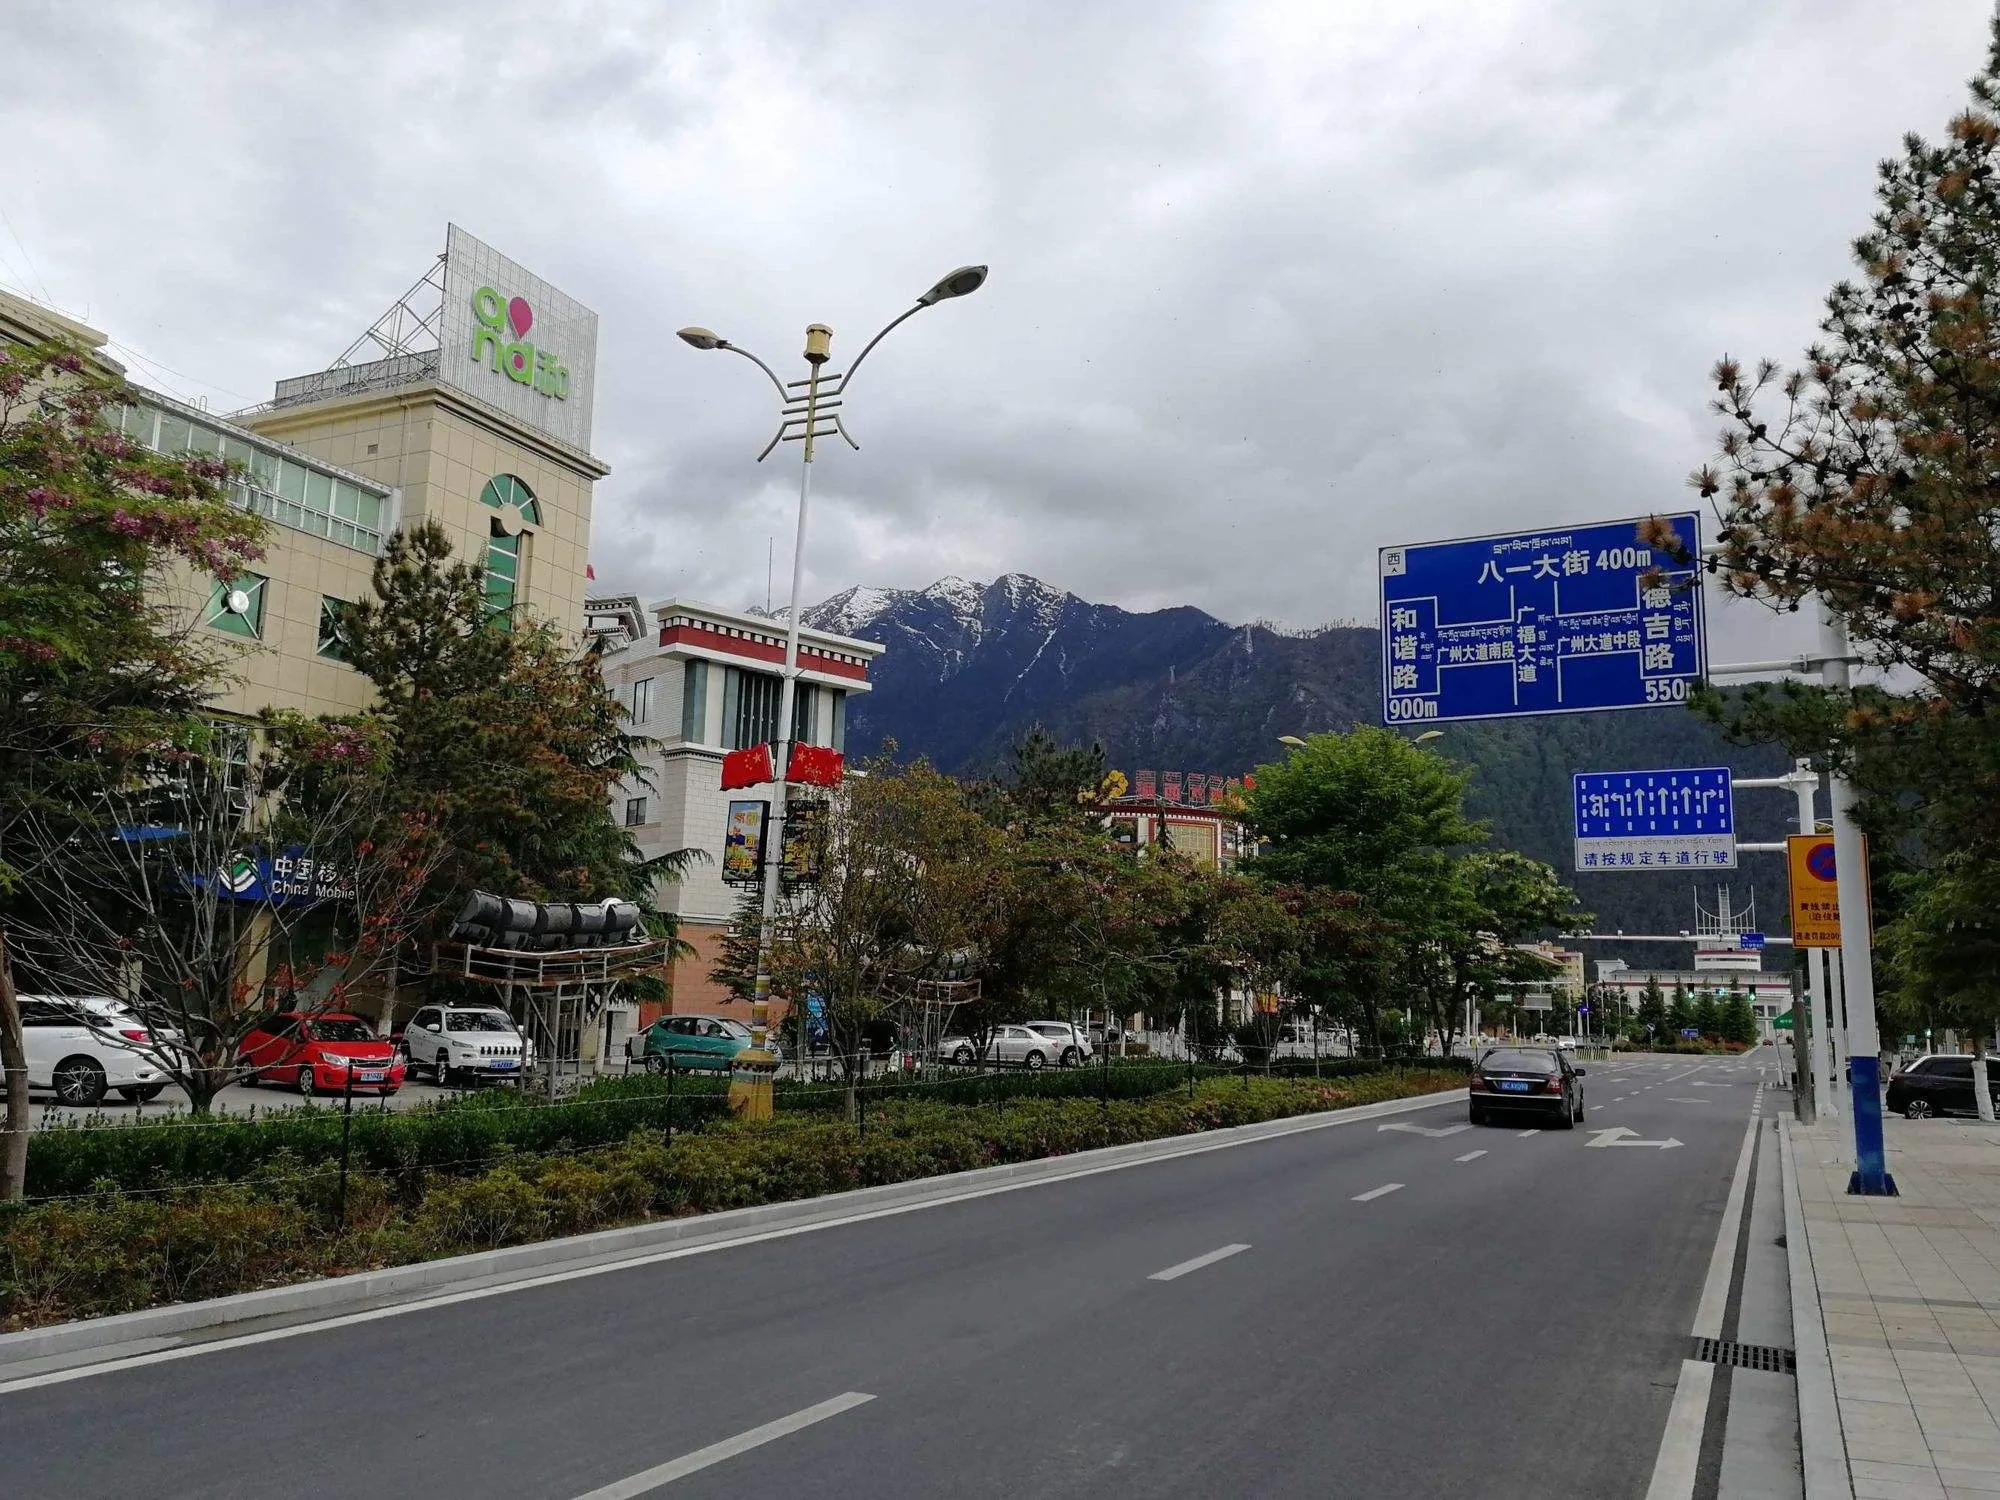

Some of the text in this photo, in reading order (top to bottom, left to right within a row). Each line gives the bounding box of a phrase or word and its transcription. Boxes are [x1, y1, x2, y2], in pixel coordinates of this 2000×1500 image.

[1387, 552, 1401, 567] 西
[1477, 547, 1651, 585] 八一大街 400m
[1641, 583, 1675, 671] 德吉路
[1391, 607, 1419, 690] 和谐路
[1436, 640, 1515, 664] 广州大道南段
[1516, 605, 1538, 683] 广福大道
[1557, 629, 1642, 655] 广州大道中段
[1389, 697, 1438, 720] 900m
[1583, 850, 1729, 867] 请按规定车道行驶
[271, 880, 355, 900] China Mobile
